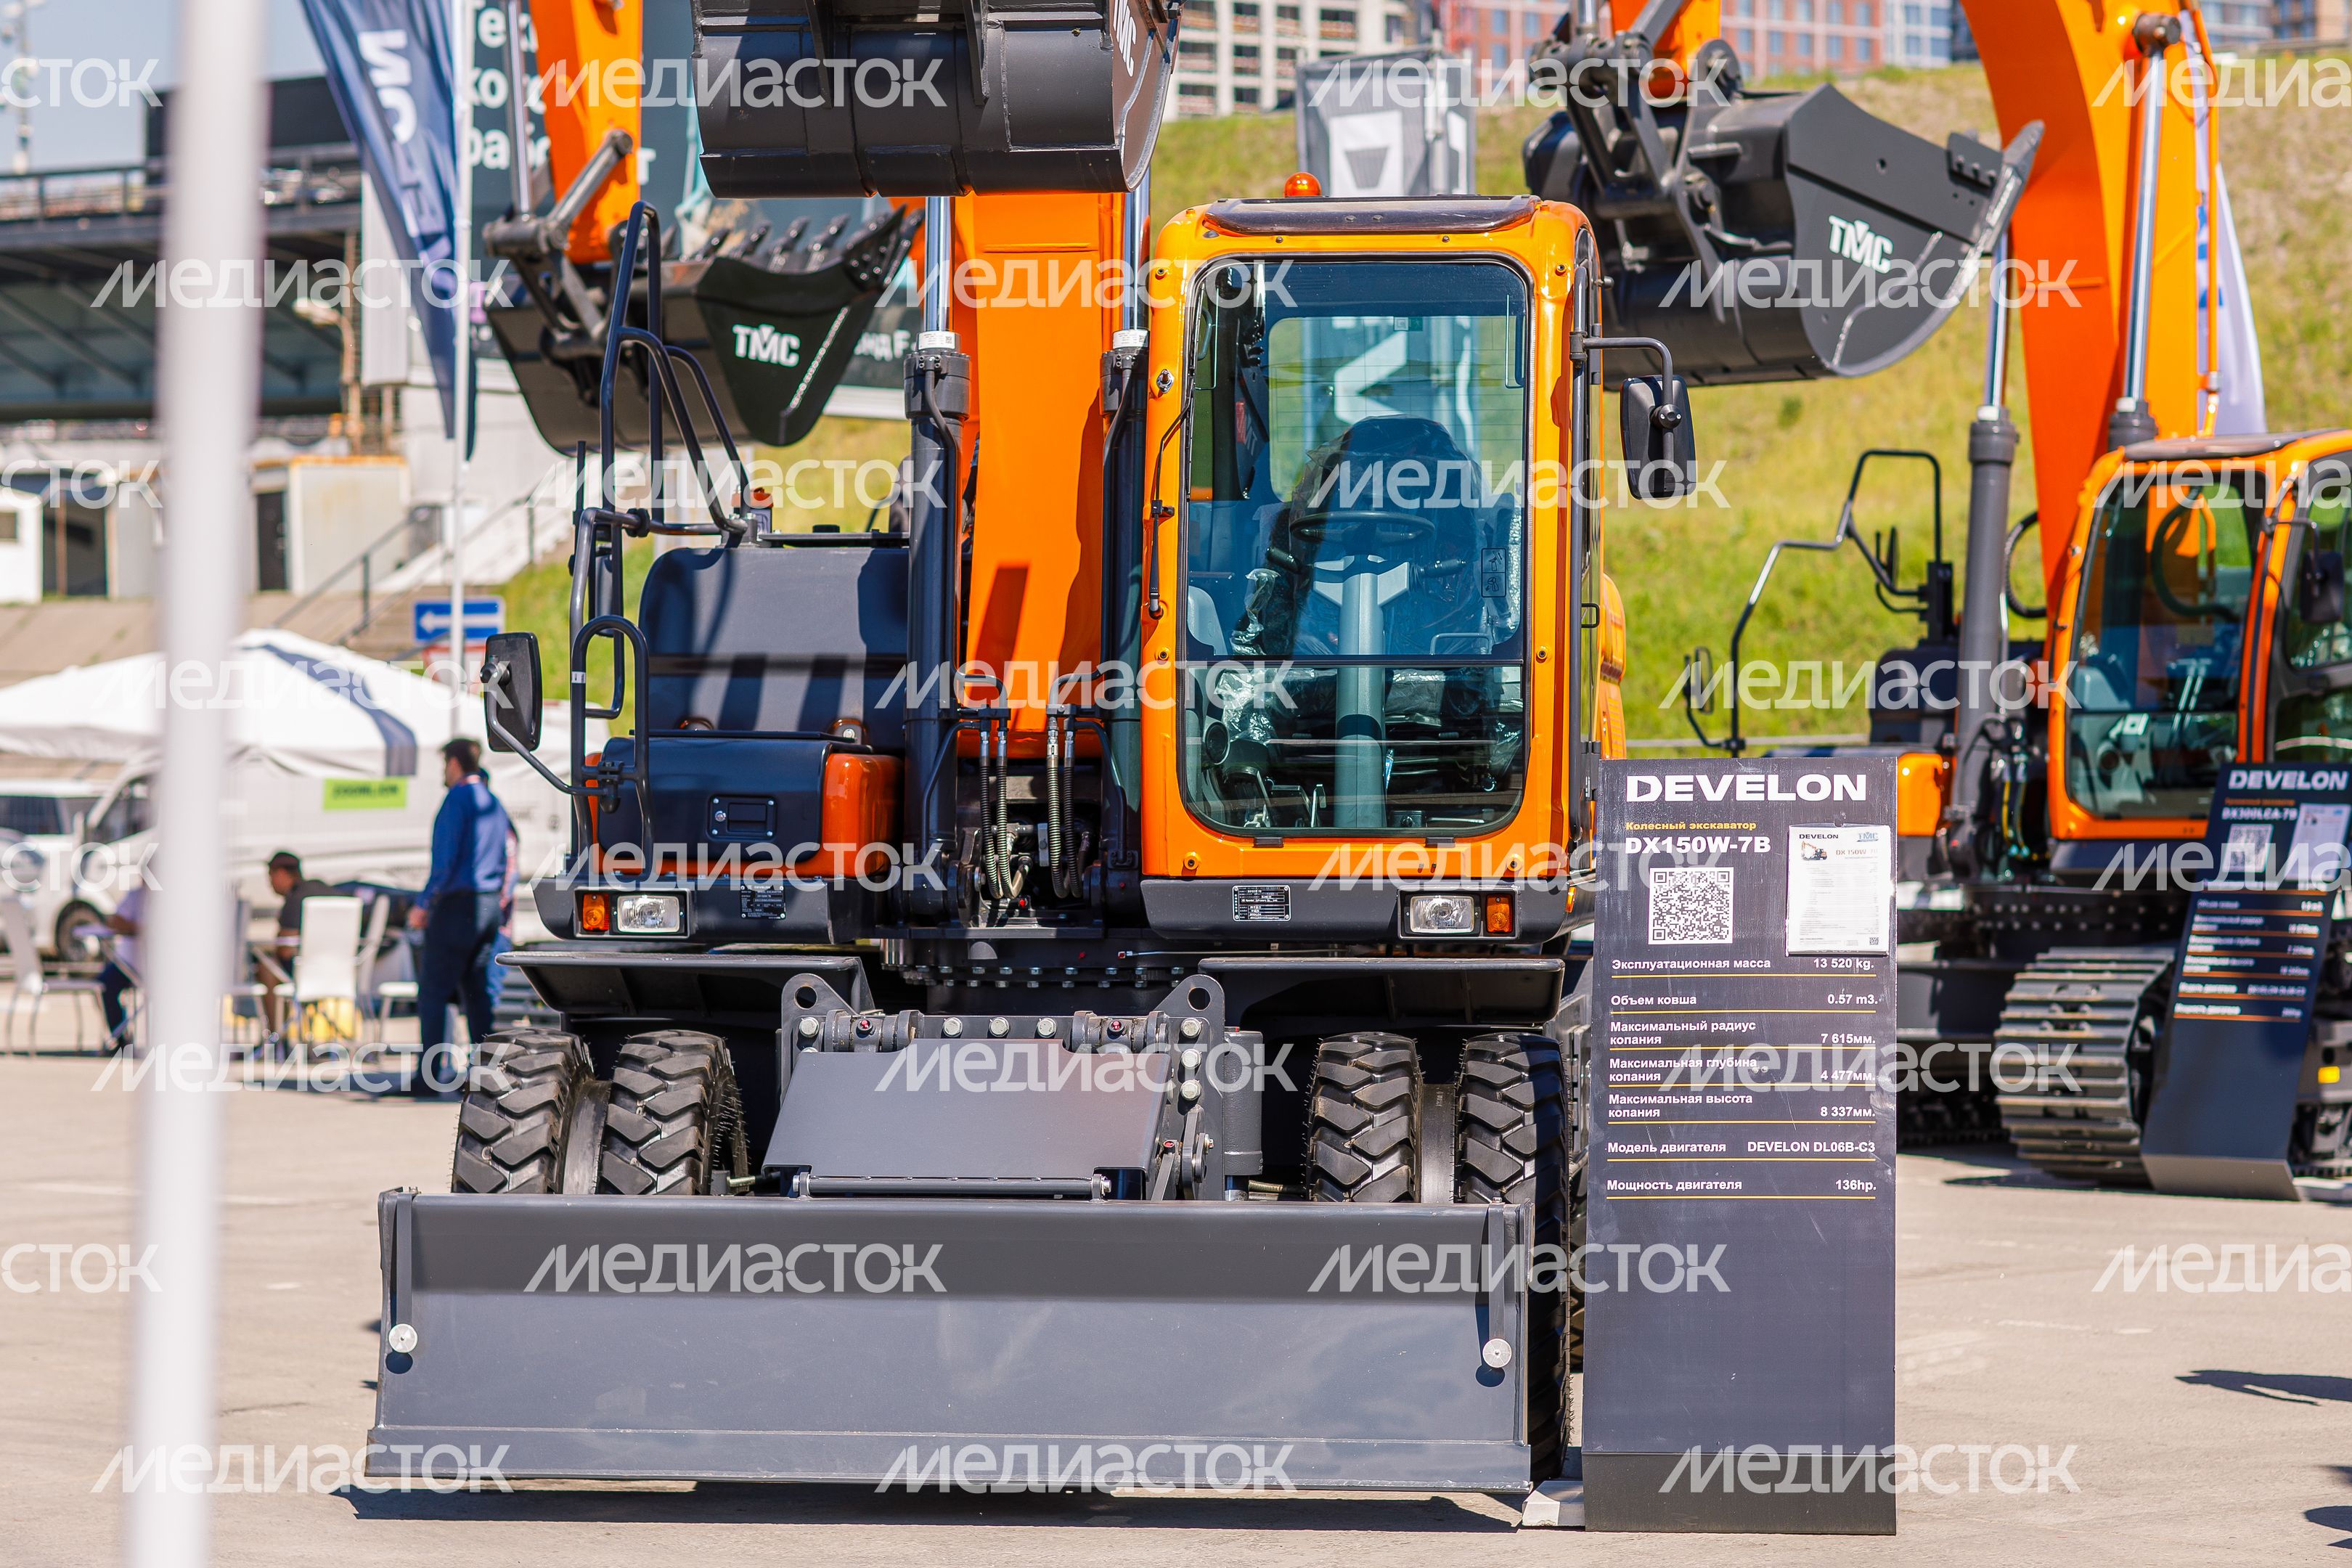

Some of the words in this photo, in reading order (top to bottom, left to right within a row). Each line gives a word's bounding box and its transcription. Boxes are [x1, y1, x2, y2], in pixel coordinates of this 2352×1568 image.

[1829, 215, 1893, 274] TMC
[732, 324, 801, 367] TMC
[2228, 769, 2349, 790] DEVELON
[1626, 774, 1866, 802] DEVELON
[1625, 822, 1686, 830] Колесный
[1689, 821, 1757, 831] экскаватор
[1625, 836, 1771, 854] DX150W-7B
[1612, 959, 1731, 971] Эксплуатационная
[1813, 958, 1828, 968] 13
[1830, 958, 1853, 968] 520
[1855, 958, 1874, 971] kg.
[1611, 995, 1654, 1006] Объем
[1657, 996, 1696, 1005] ковша
[1827, 994, 1853, 1005] 0.57
[1855, 994, 1878, 1005] m3.
[1610, 1021, 1708, 1032] Максимальный
[1711, 1021, 1756, 1034] радиус
[1609, 1035, 1662, 1045] копания
[1821, 1034, 1828, 1044] 7
[1831, 1033, 1876, 1044] 615мм.
[1609, 1058, 1703, 1069] Максимальная
[1706, 1058, 1757, 1069] глубина
[1609, 1071, 1661, 1082] копания
[1820, 1071, 1828, 1081] 4
[1831, 1070, 1876, 1081] 477мм.
[1609, 1094, 1702, 1105] Максимальная
[1705, 1095, 1753, 1104] высота
[1608, 1108, 1660, 1118] копания
[1820, 1106, 1828, 1117] 8
[1831, 1106, 1876, 1117] 337мм.
[1607, 1142, 1657, 1153] Модель
[1660, 1143, 1726, 1153] двигателя
[1747, 1141, 1810, 1153] DEVELON
[1813, 1141, 1876, 1153] DL06B-C3
[1606, 1180, 1673, 1191] Мощность
[1675, 1180, 1742, 1191] двигателя
[1835, 1180, 1877, 1192] 136hp.
